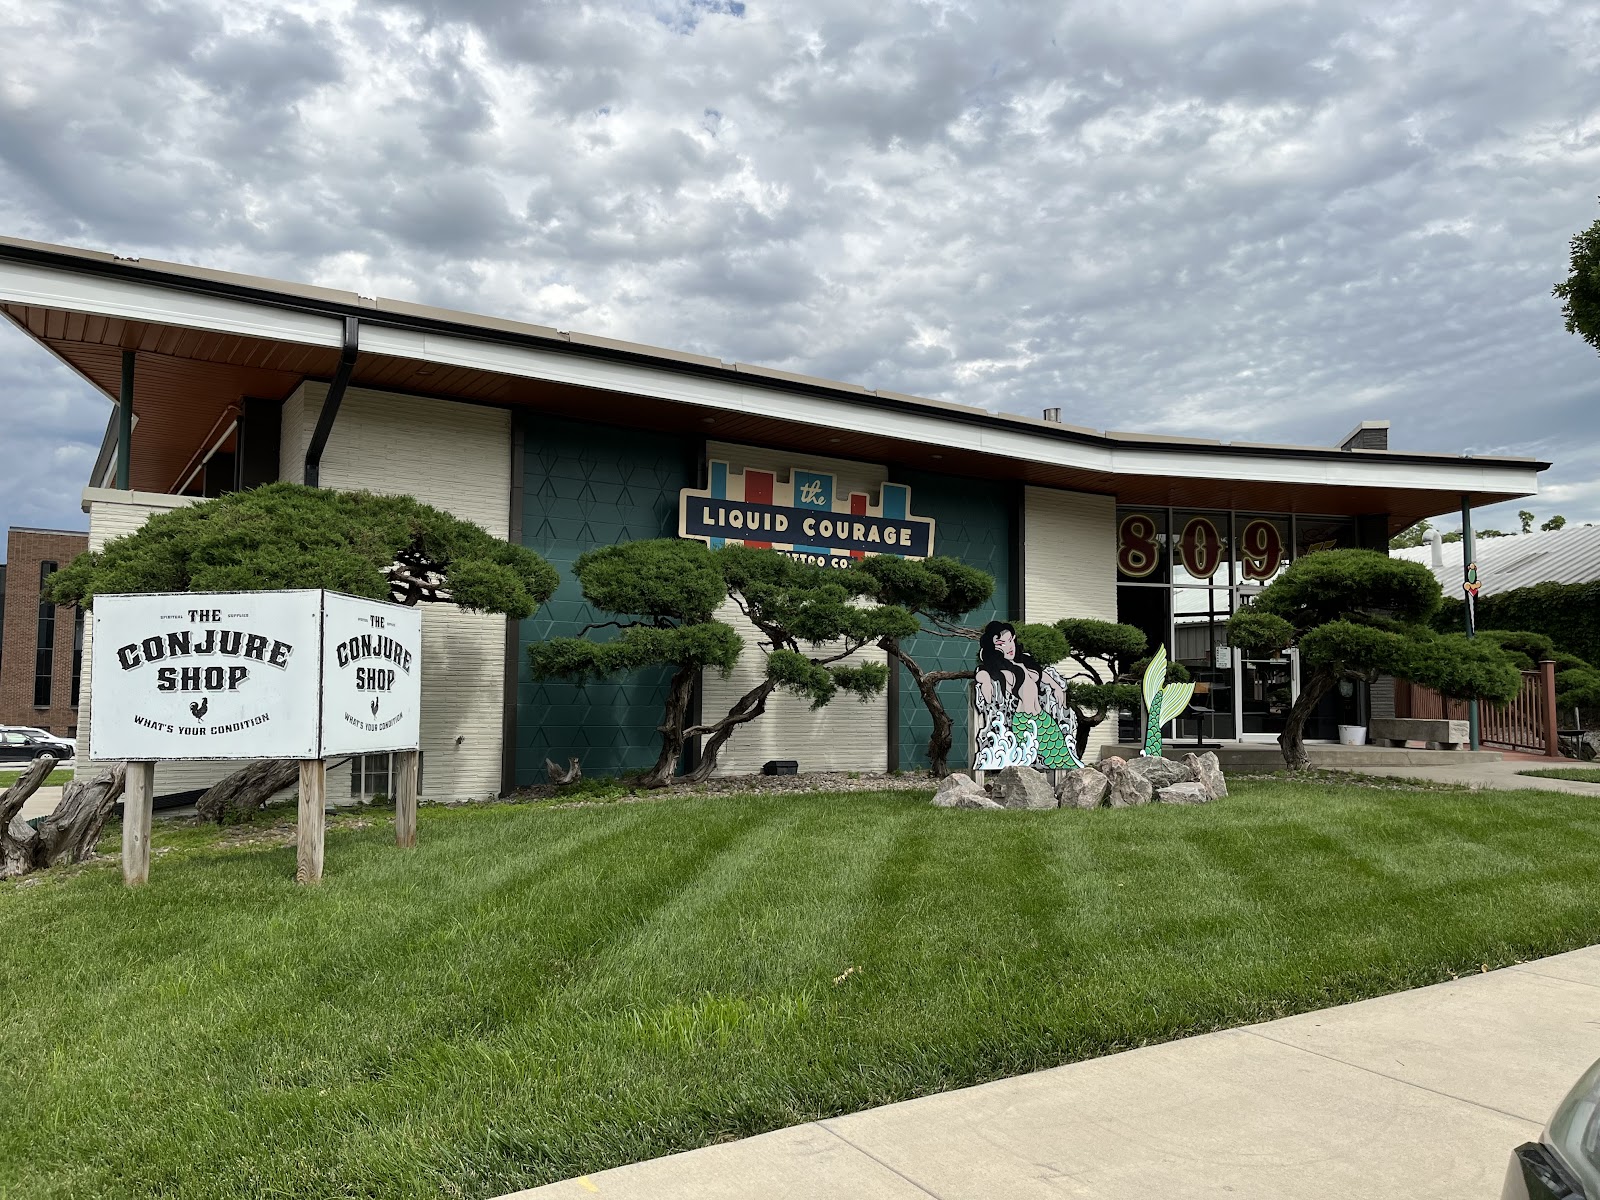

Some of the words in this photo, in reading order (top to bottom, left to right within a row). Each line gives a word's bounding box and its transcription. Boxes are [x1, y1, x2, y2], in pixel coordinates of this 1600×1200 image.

[800, 480, 827, 506] the
[703, 506, 789, 533] LIQUID
[802, 517, 912, 547] COURAGE
[1117, 514, 1285, 581] 809
[187, 609, 222, 623] THE
[370, 615, 385, 629] THE
[116, 629, 294, 671] CONJURE
[336, 634, 413, 676] CONJURE
[157, 666, 250, 693] SHOP
[355, 667, 396, 693] SHOP
[134, 714, 174, 733] WHAT'S
[178, 726, 207, 736] YOUR
[210, 712, 271, 735] CONDITION
[344, 711, 364, 730] WHAT'S
[365, 723, 378, 732] YOUR
[379, 711, 403, 731] CONDITION
